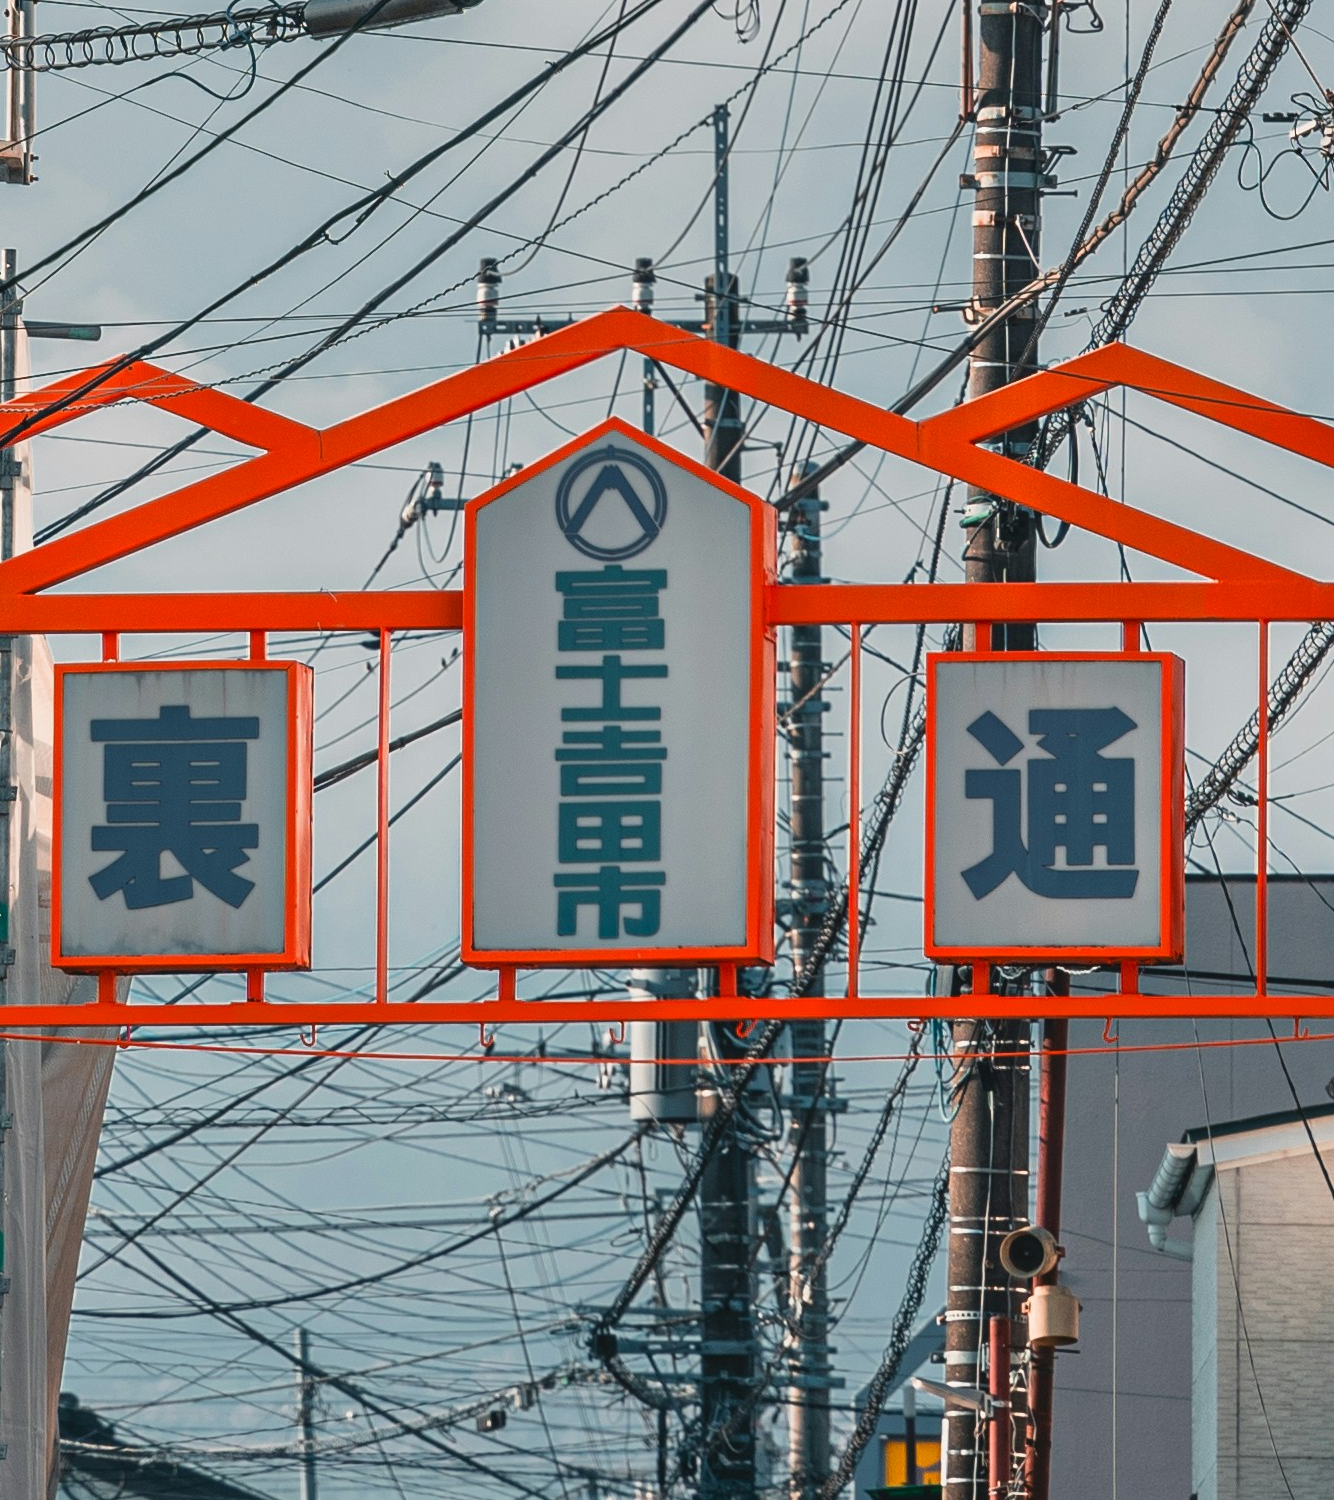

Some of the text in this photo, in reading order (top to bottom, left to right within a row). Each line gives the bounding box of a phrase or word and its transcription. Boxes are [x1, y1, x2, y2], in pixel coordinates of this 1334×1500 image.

[87, 704, 260, 909] 裏
[960, 706, 1140, 901] 通
[553, 563, 669, 940] 富士吉田市
